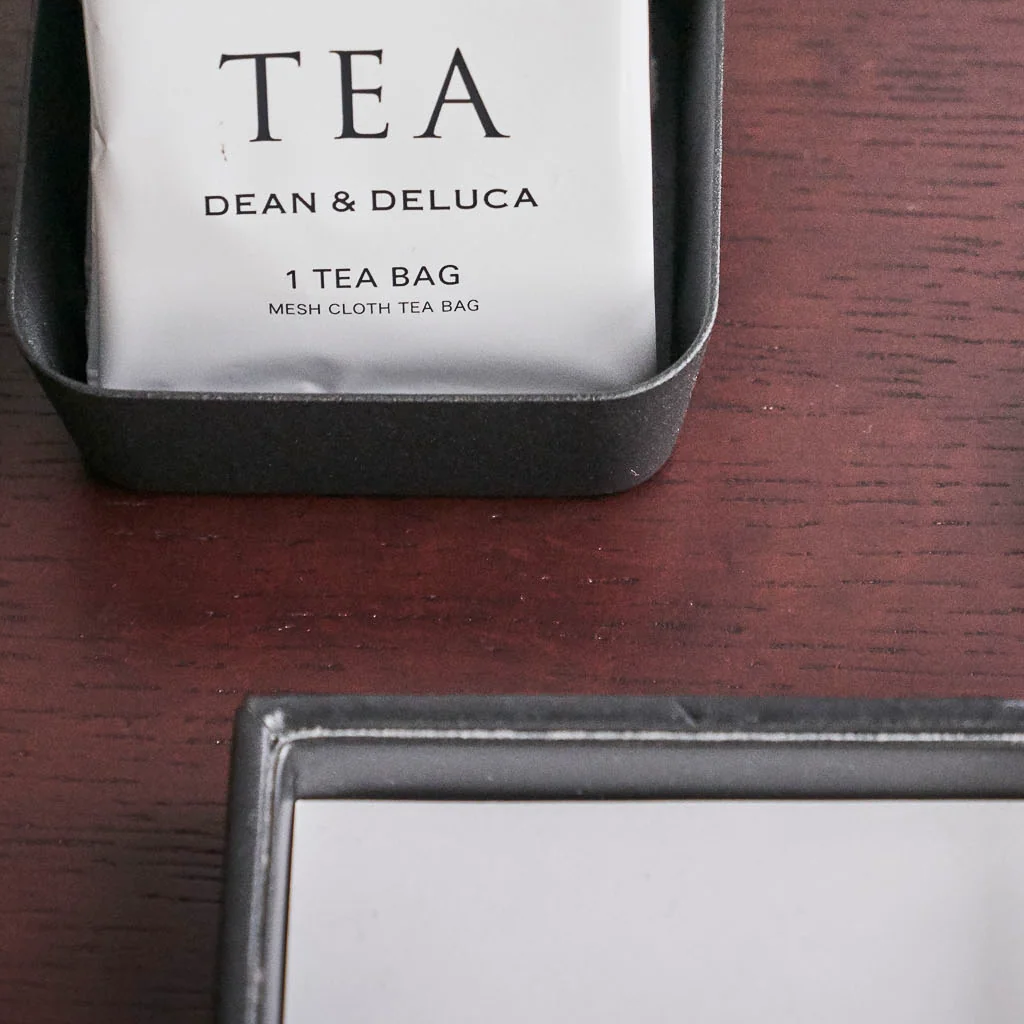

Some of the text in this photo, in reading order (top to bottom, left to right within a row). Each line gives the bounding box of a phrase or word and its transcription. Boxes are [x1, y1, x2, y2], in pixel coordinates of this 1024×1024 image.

[219, 47, 511, 143] TEA
[204, 187, 539, 217] DEAN & DELUCA
[286, 264, 461, 290] 1 TEA BAG
[269, 299, 480, 316] MESH CLOTH TEA BAG
